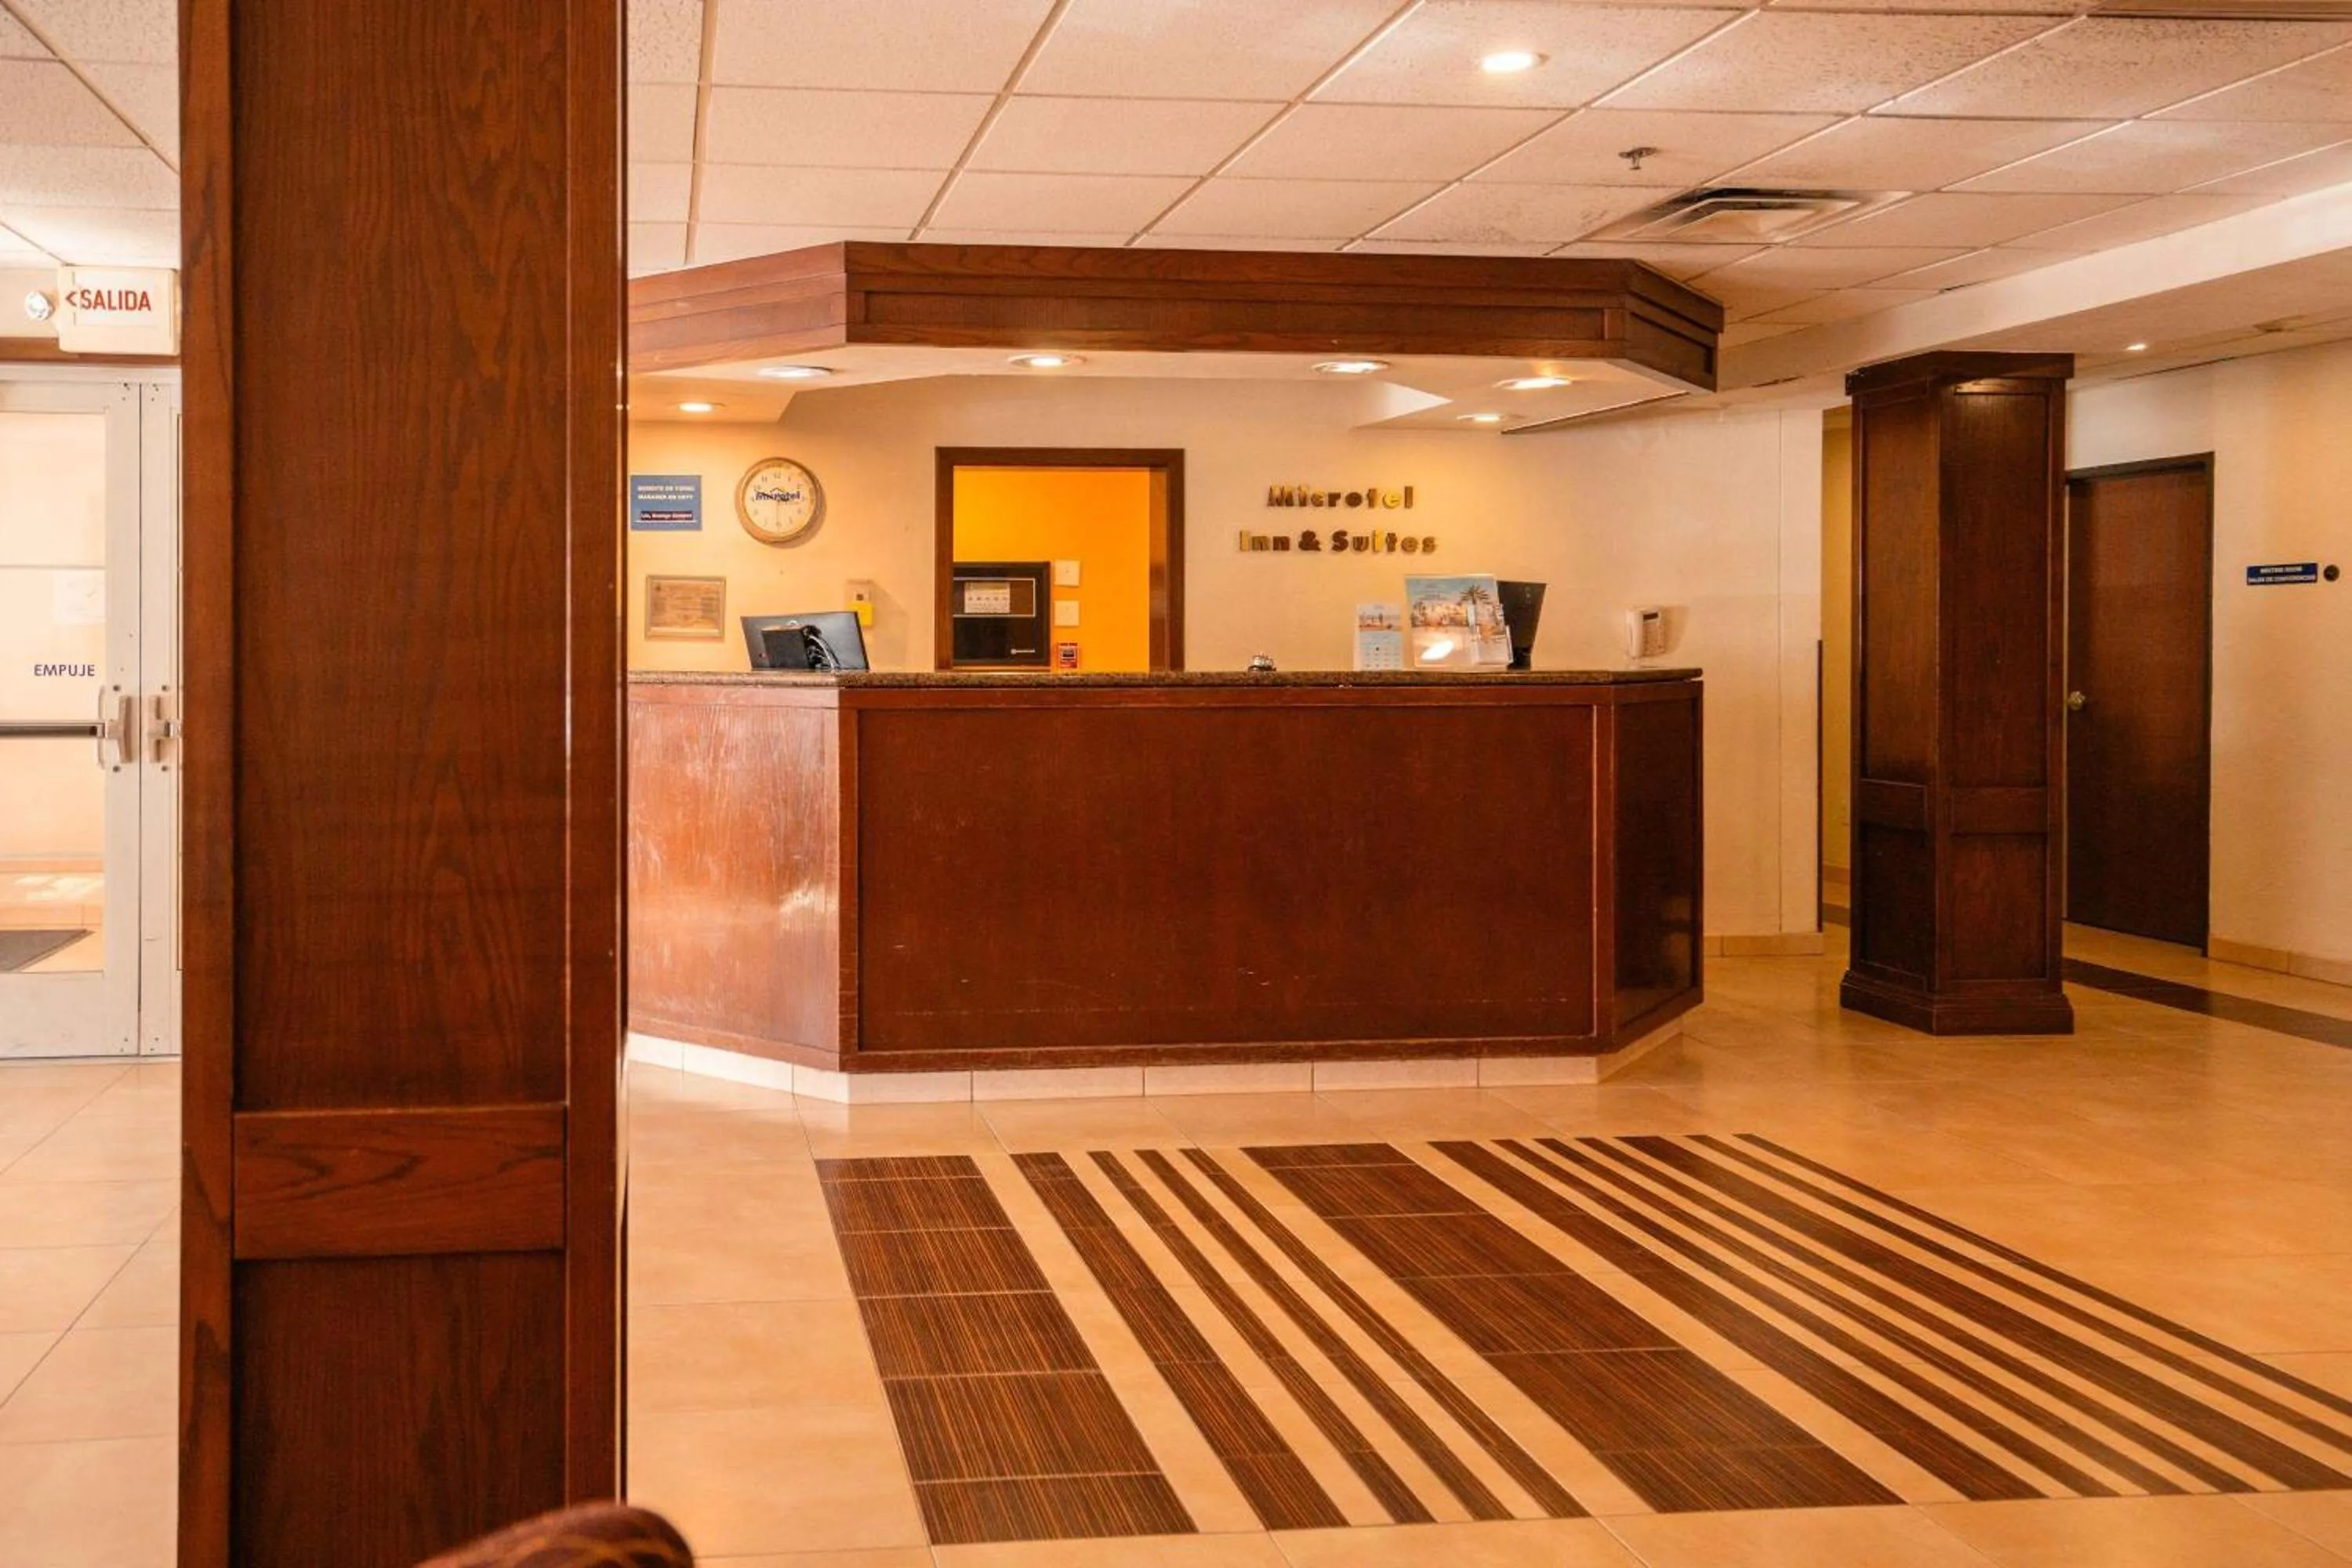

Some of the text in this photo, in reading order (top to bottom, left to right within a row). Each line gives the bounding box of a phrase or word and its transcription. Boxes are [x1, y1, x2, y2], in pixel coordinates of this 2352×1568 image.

[80, 289, 151, 311] SALIDA
[1267, 485, 1414, 509] Microtel
[1240, 528, 1439, 554] Inn & Suites
[34, 663, 96, 677] EMPUJE
